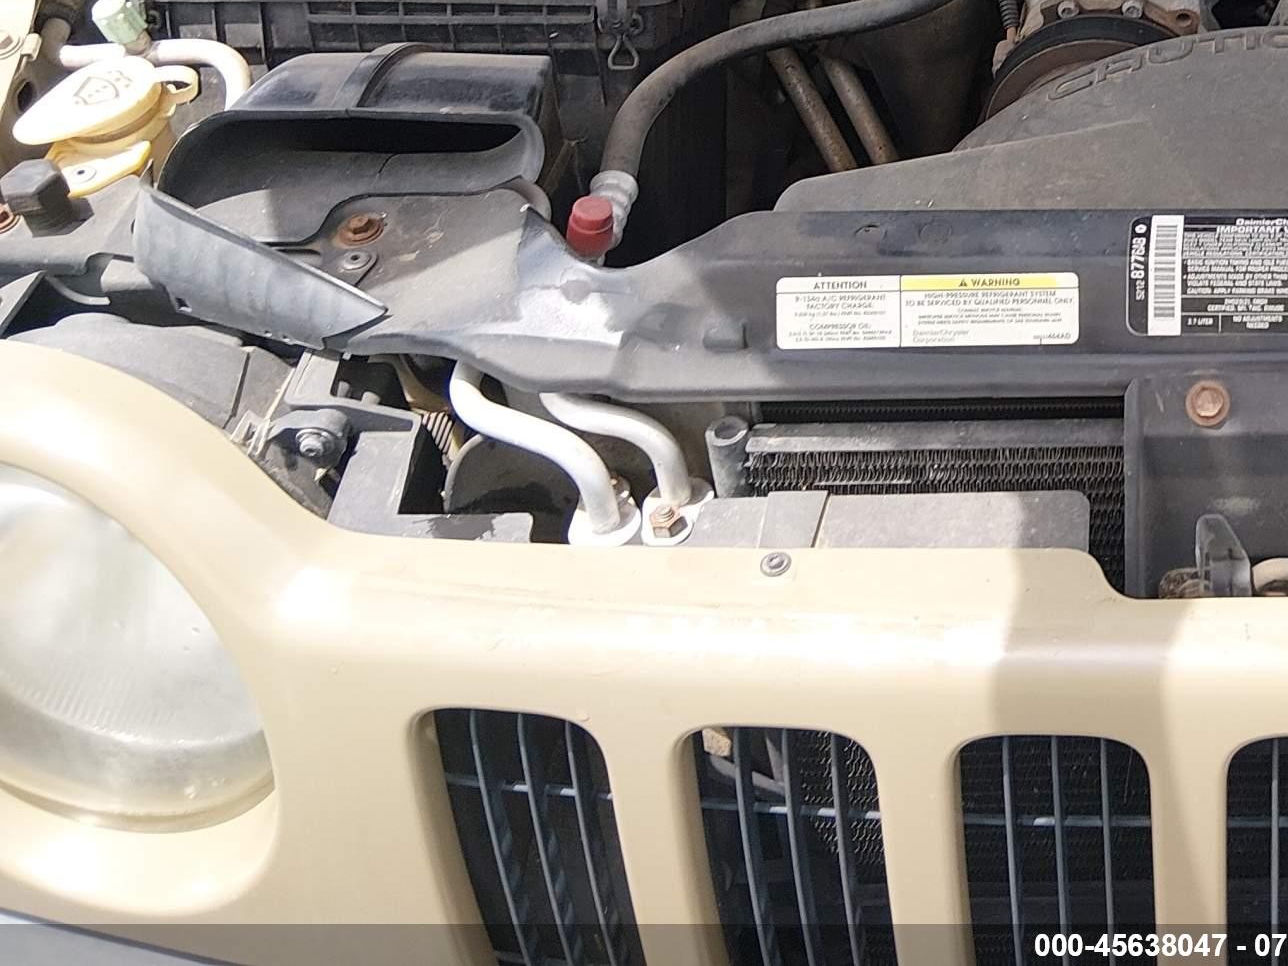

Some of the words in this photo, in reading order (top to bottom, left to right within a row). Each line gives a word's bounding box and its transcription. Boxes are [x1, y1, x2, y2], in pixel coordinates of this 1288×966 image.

[1216, 225, 1282, 234] IMPORTANT
[813, 280, 867, 290] ATTENTION
[970, 278, 1020, 288] WARNING
